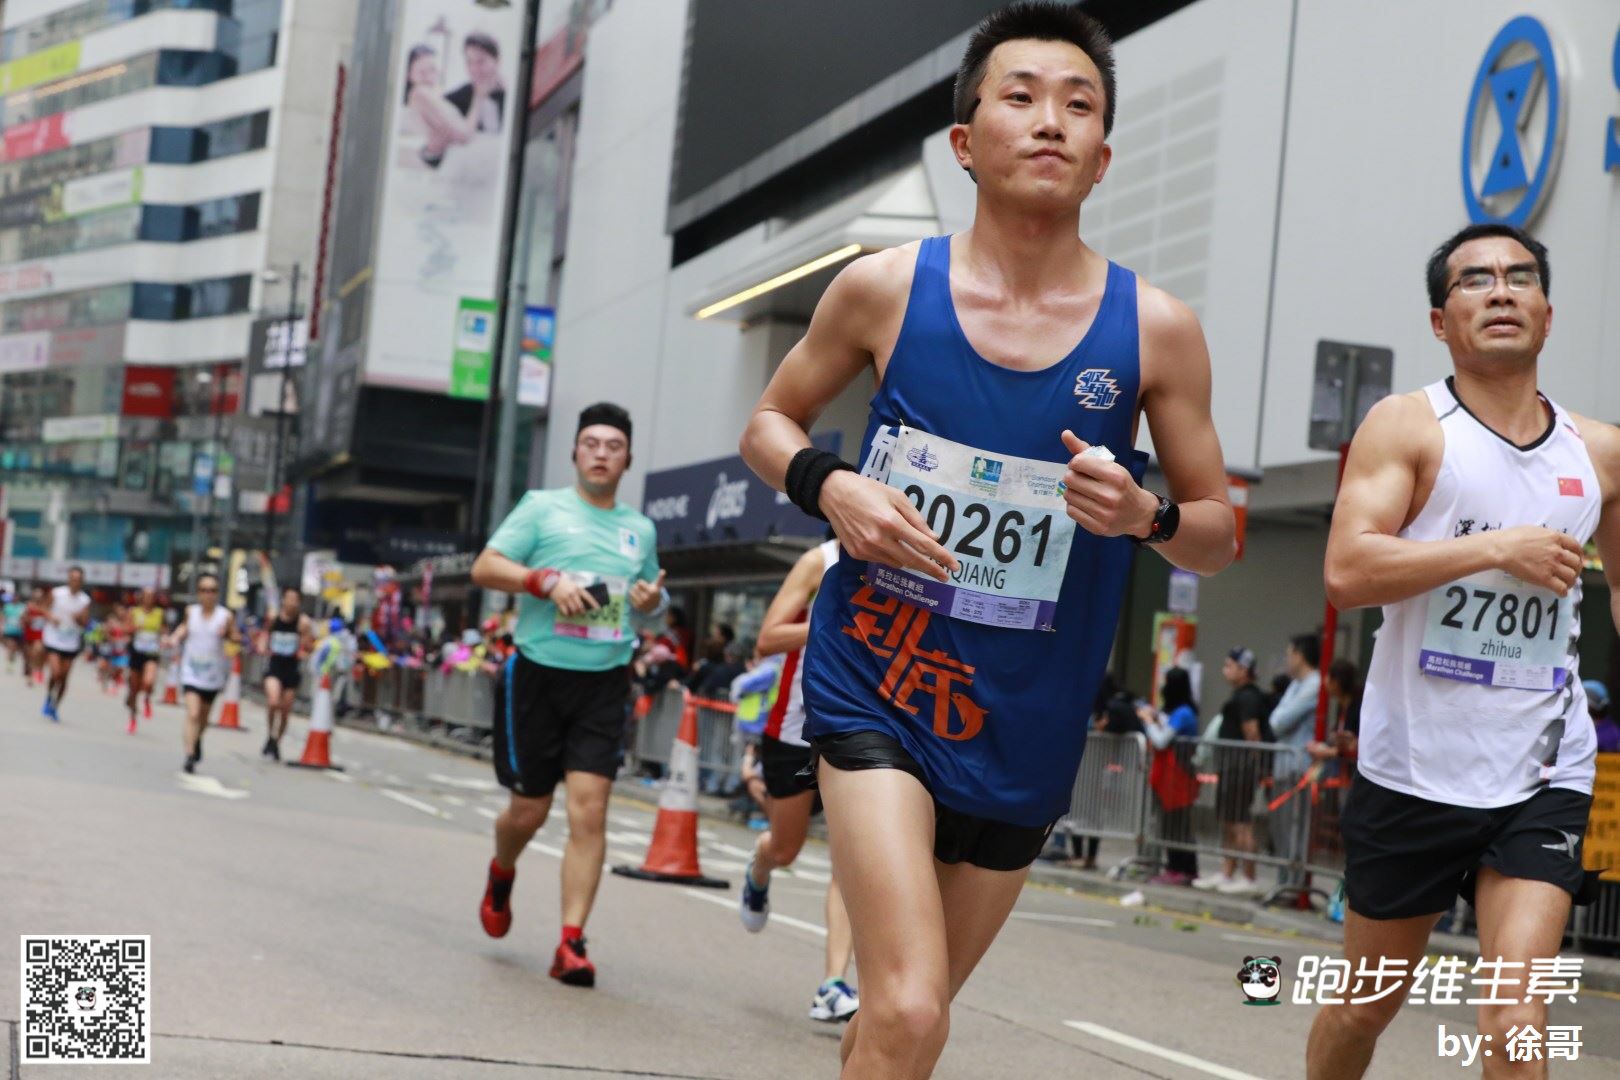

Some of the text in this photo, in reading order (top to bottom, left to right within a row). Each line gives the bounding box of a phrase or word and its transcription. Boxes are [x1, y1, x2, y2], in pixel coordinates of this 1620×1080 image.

[874, 577, 939, 607] Marathon Challenge
[1441, 585, 1559, 640] 27801
[1480, 638, 1522, 659] zhihua
